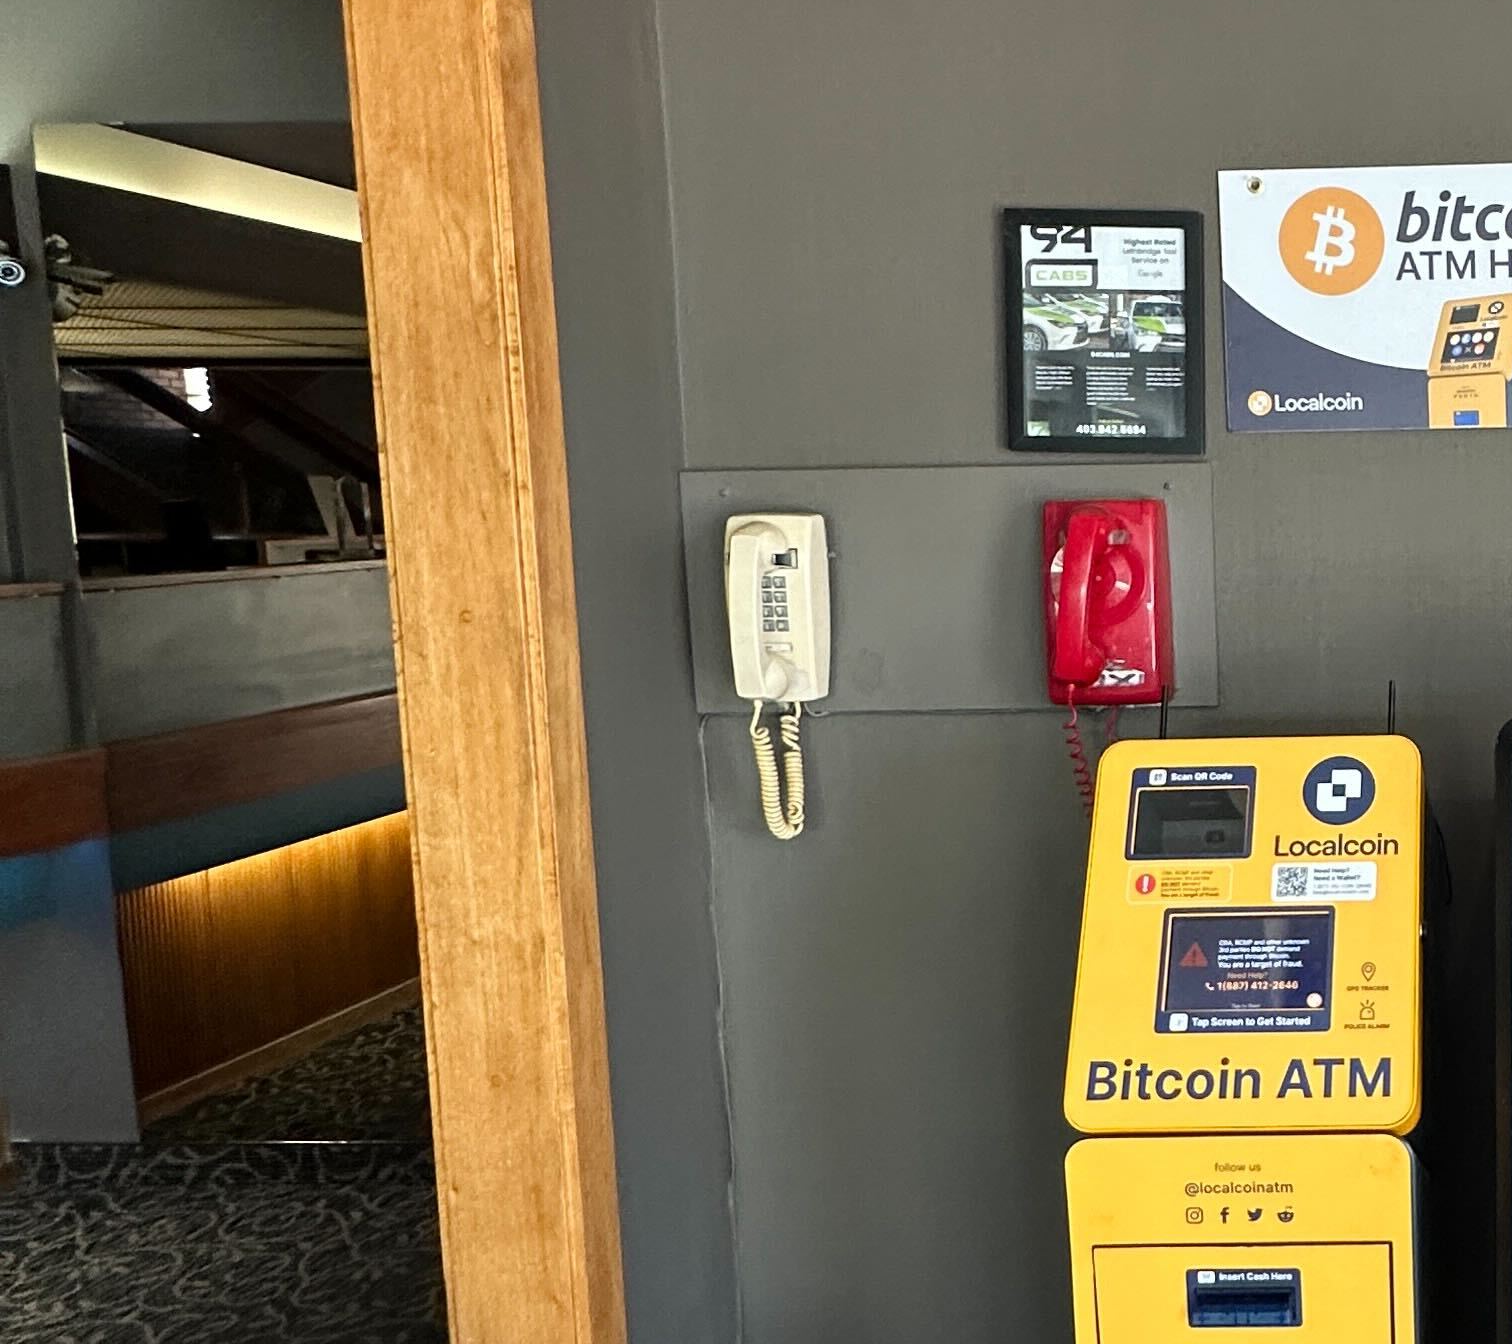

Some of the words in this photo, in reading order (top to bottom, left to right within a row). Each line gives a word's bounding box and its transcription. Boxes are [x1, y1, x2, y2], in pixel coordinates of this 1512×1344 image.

[1030, 226, 1092, 253] 94
[1396, 250, 1476, 280] ATM
[1036, 270, 1088, 281] CABS
[1471, 361, 1491, 369] ATM
[1274, 391, 1363, 414] Localcoin
[1171, 773, 1193, 781] Scan
[1194, 772, 1208, 781] QR
[1209, 771, 1233, 780] Code
[1274, 833, 1399, 857] Localcoin
[1251, 961, 1272, 969] target
[1273, 960, 1282, 968] of
[1192, 1017, 1210, 1028] Tap
[1211, 1017, 1244, 1027] Screen
[1246, 1017, 1255, 1026] to
[1257, 1016, 1274, 1026] Get
[1276, 1016, 1311, 1026] Started
[1086, 1057, 1260, 1101] Bitcoin
[1277, 1057, 1392, 1099] ATM
[1214, 1162, 1246, 1172] follow
[1249, 1163, 1262, 1172] us
[1185, 1181, 1294, 1197] @localcoinatm
[1219, 1272, 1245, 1280] Insert
[1246, 1272, 1269, 1280] Cash
[1270, 1272, 1293, 1280] Here
